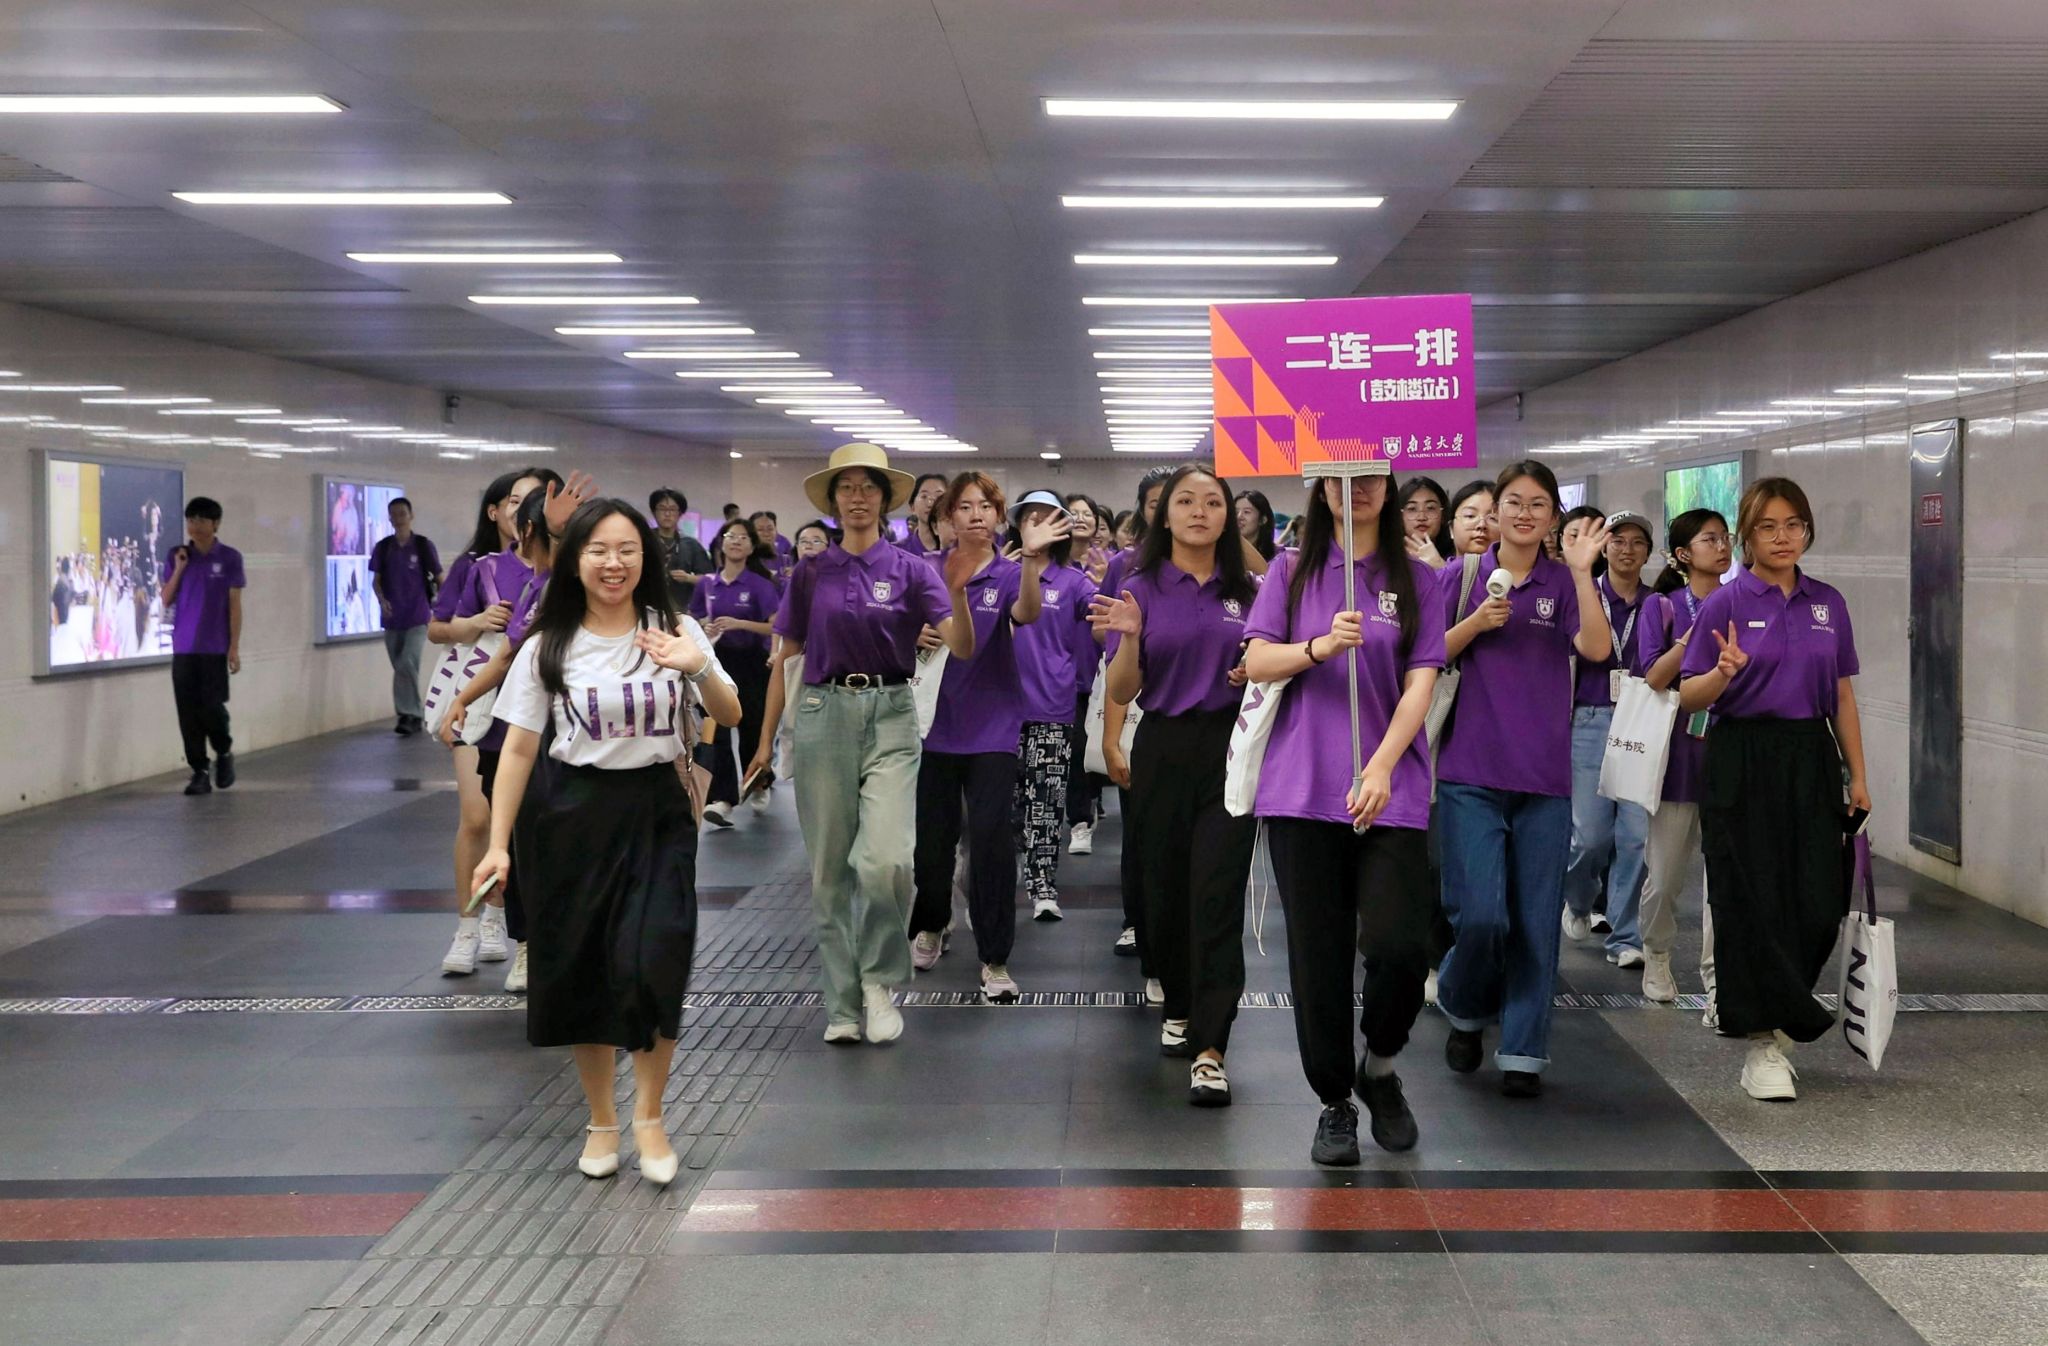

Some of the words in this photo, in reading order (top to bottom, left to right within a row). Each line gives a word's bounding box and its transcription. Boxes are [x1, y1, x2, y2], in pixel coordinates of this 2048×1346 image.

[1286, 328, 1459, 370] 二连一排
[561, 679, 677, 741] NJU
[1843, 946, 1869, 1061] NJU
